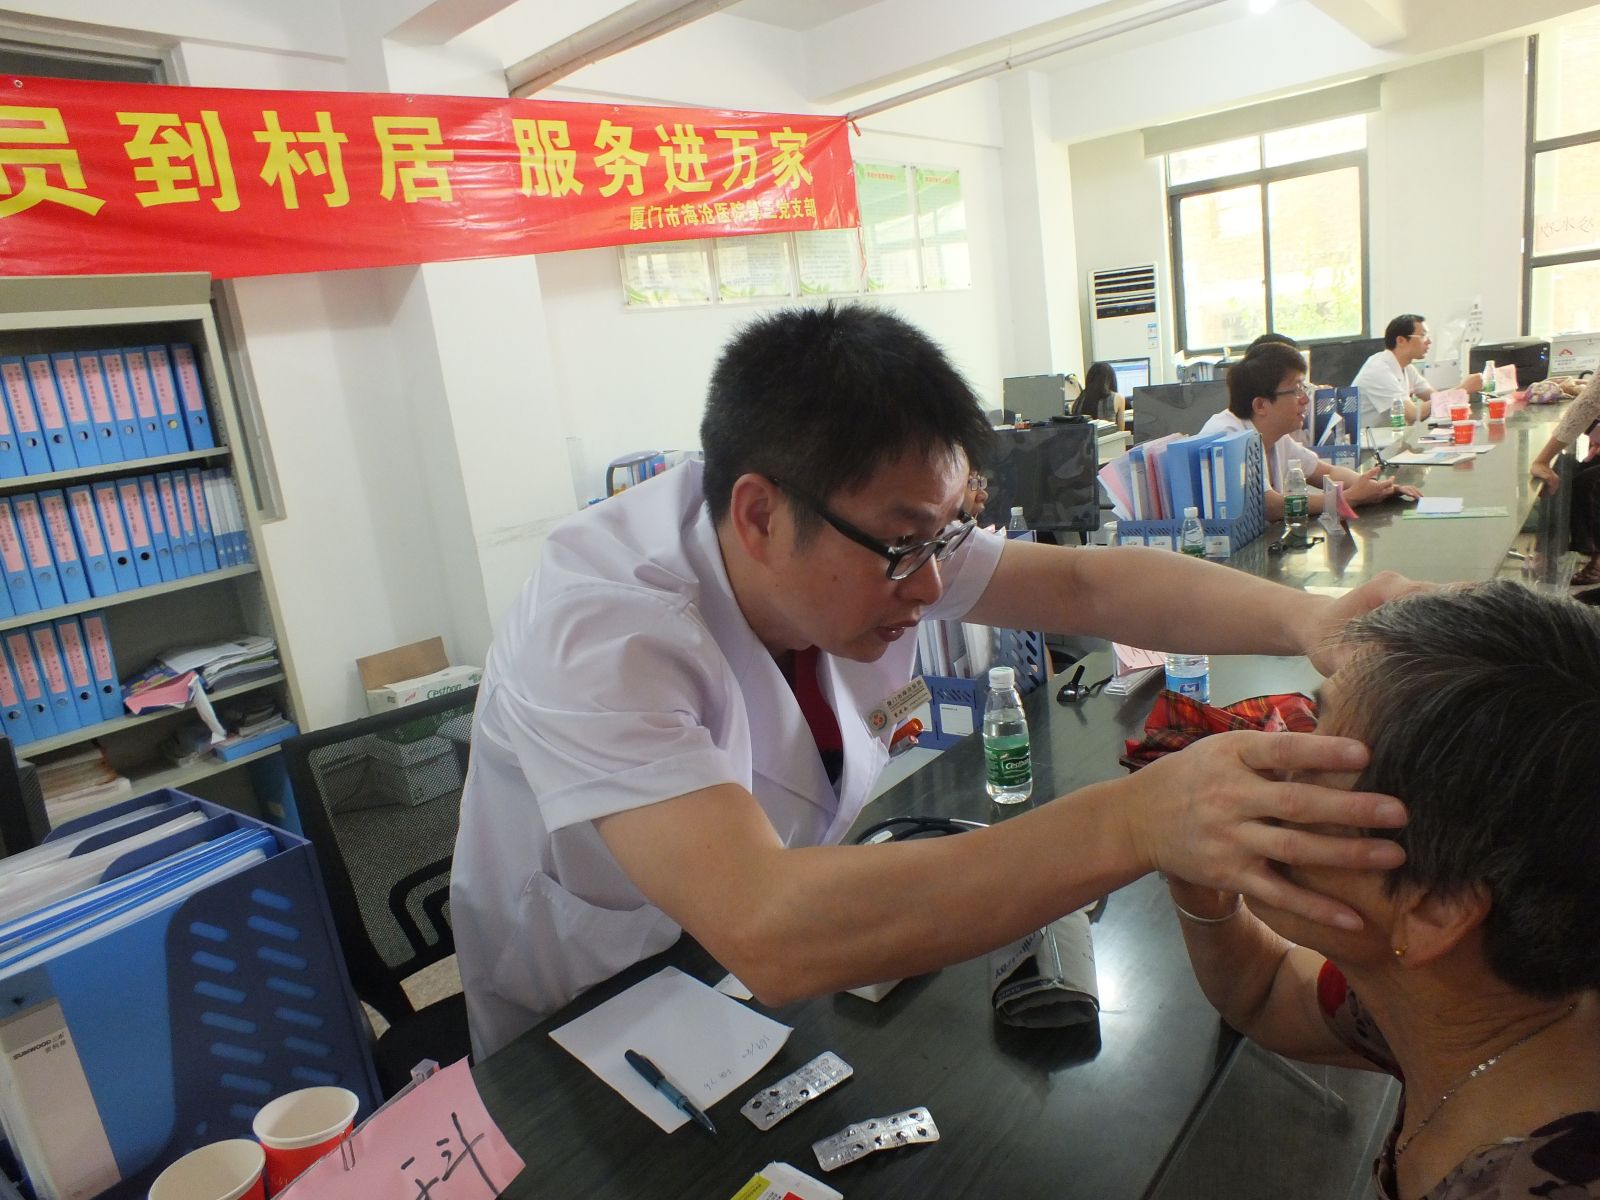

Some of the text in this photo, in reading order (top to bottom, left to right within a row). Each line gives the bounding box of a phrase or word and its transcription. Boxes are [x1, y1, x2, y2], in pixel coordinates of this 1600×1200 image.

[0, 105, 814, 218] 员到村居 服务进万家
